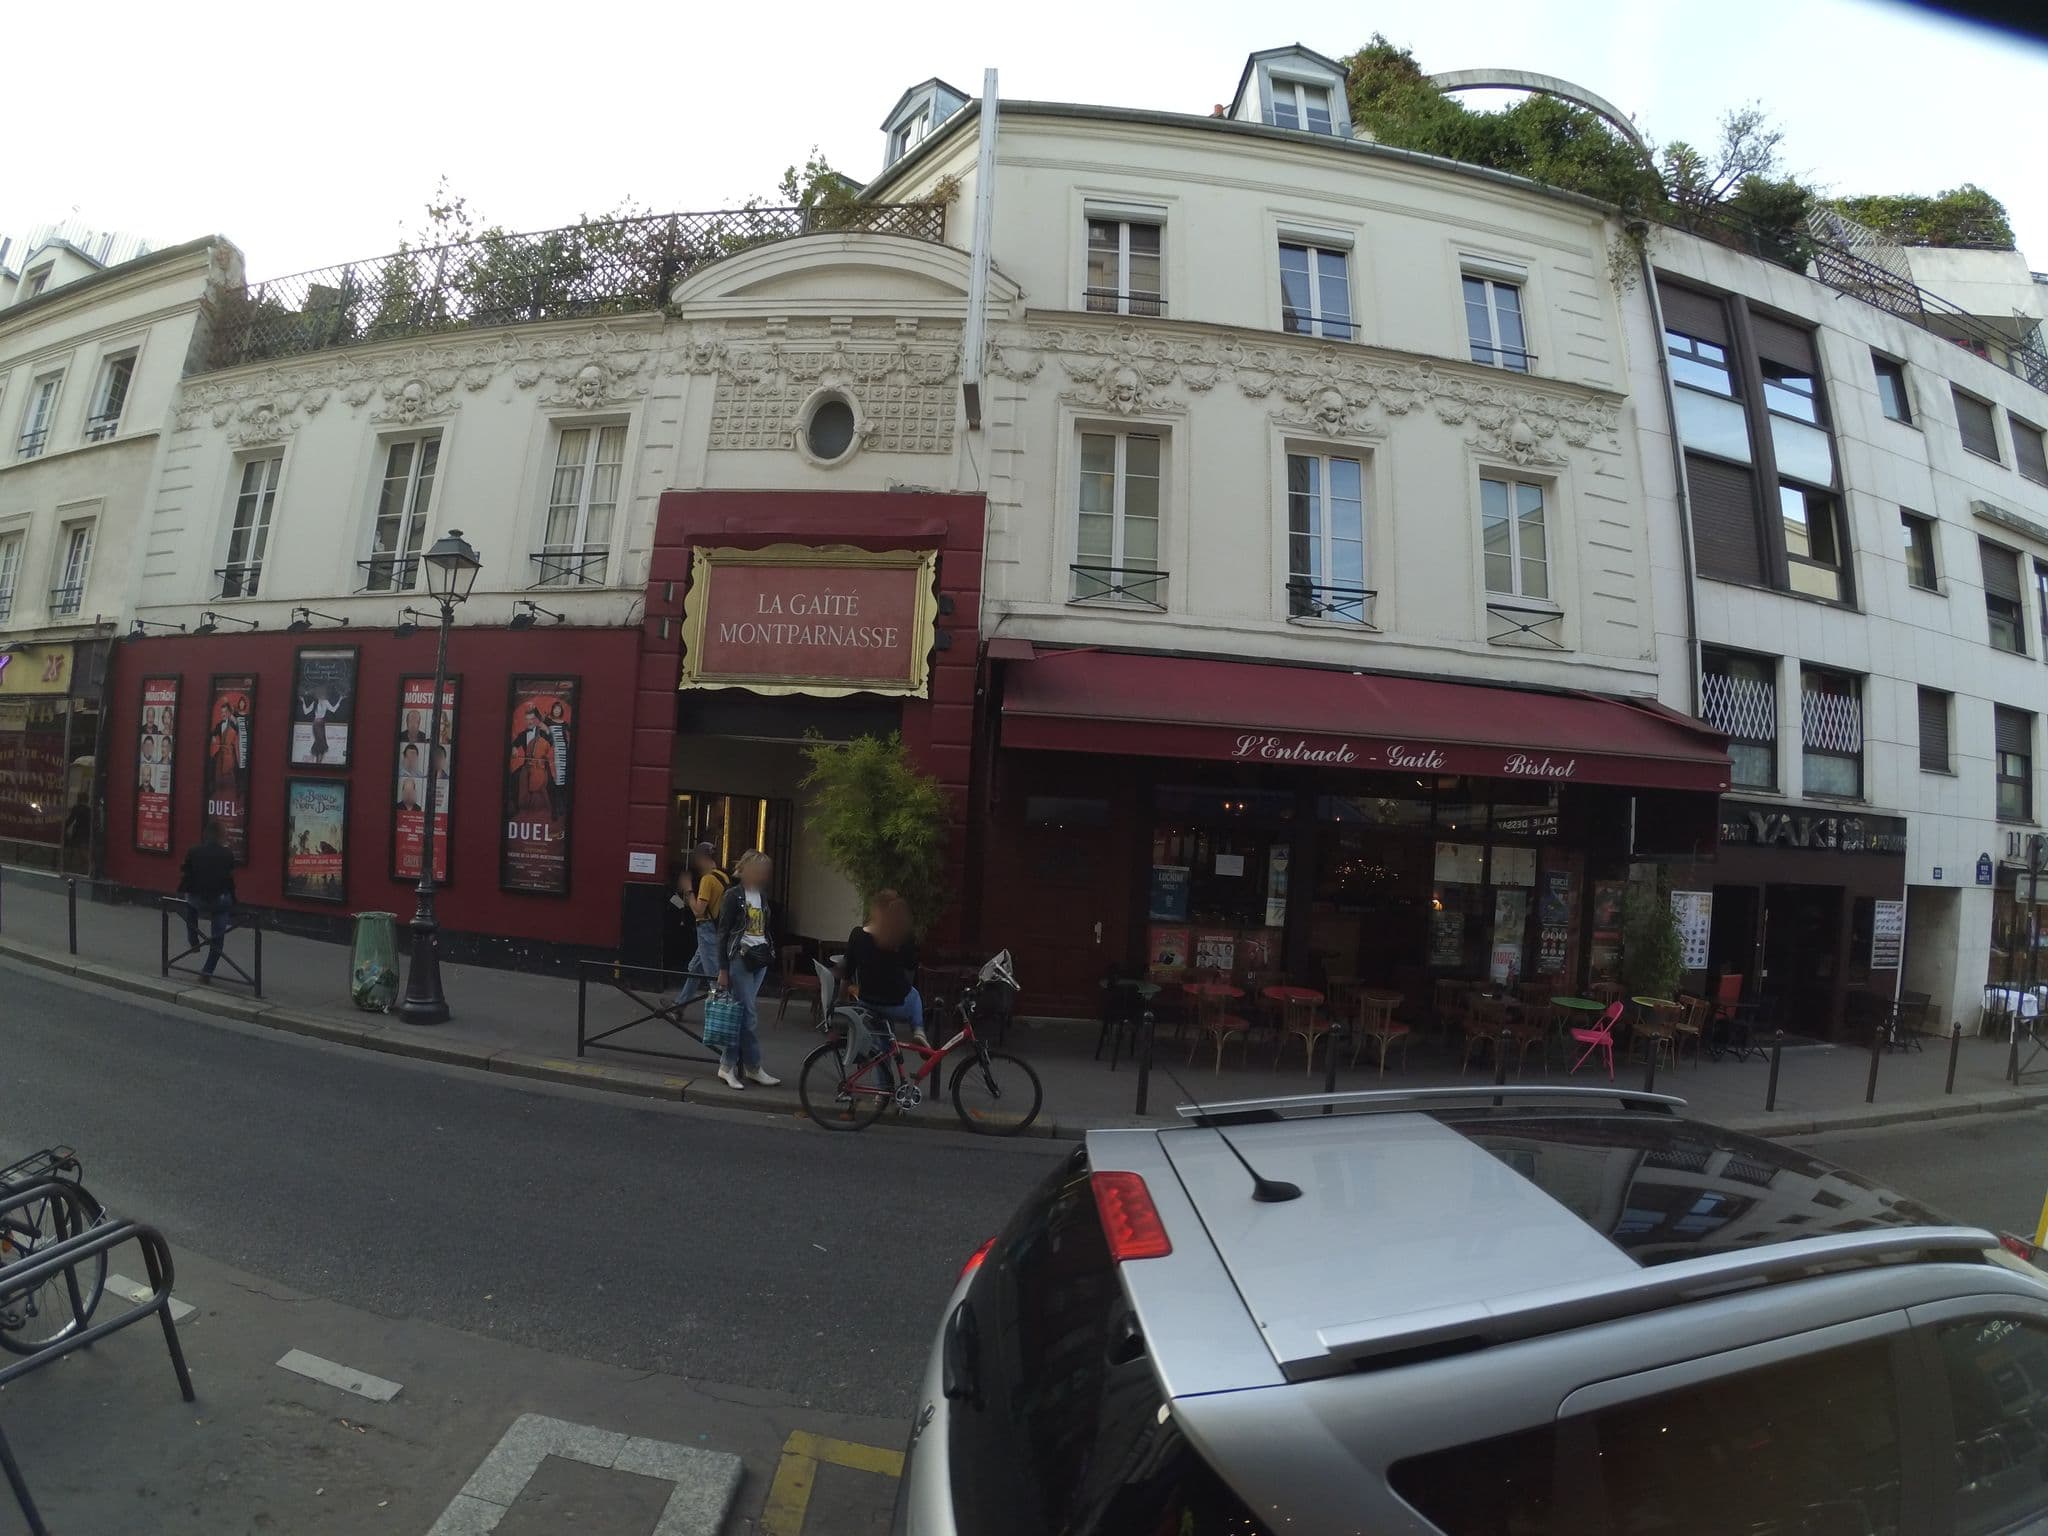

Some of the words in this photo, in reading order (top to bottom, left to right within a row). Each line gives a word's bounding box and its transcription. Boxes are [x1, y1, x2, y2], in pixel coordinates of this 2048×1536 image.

[757, 593, 783, 614] LA
[790, 587, 860, 617] GAÎTÉ
[719, 623, 899, 649] MONTPARNASSE
[1231, 735, 1360, 764] L'Entracte
[1503, 753, 1576, 778] Bistrot
[208, 799, 238, 817] DUEL
[508, 821, 553, 842] DUEL
